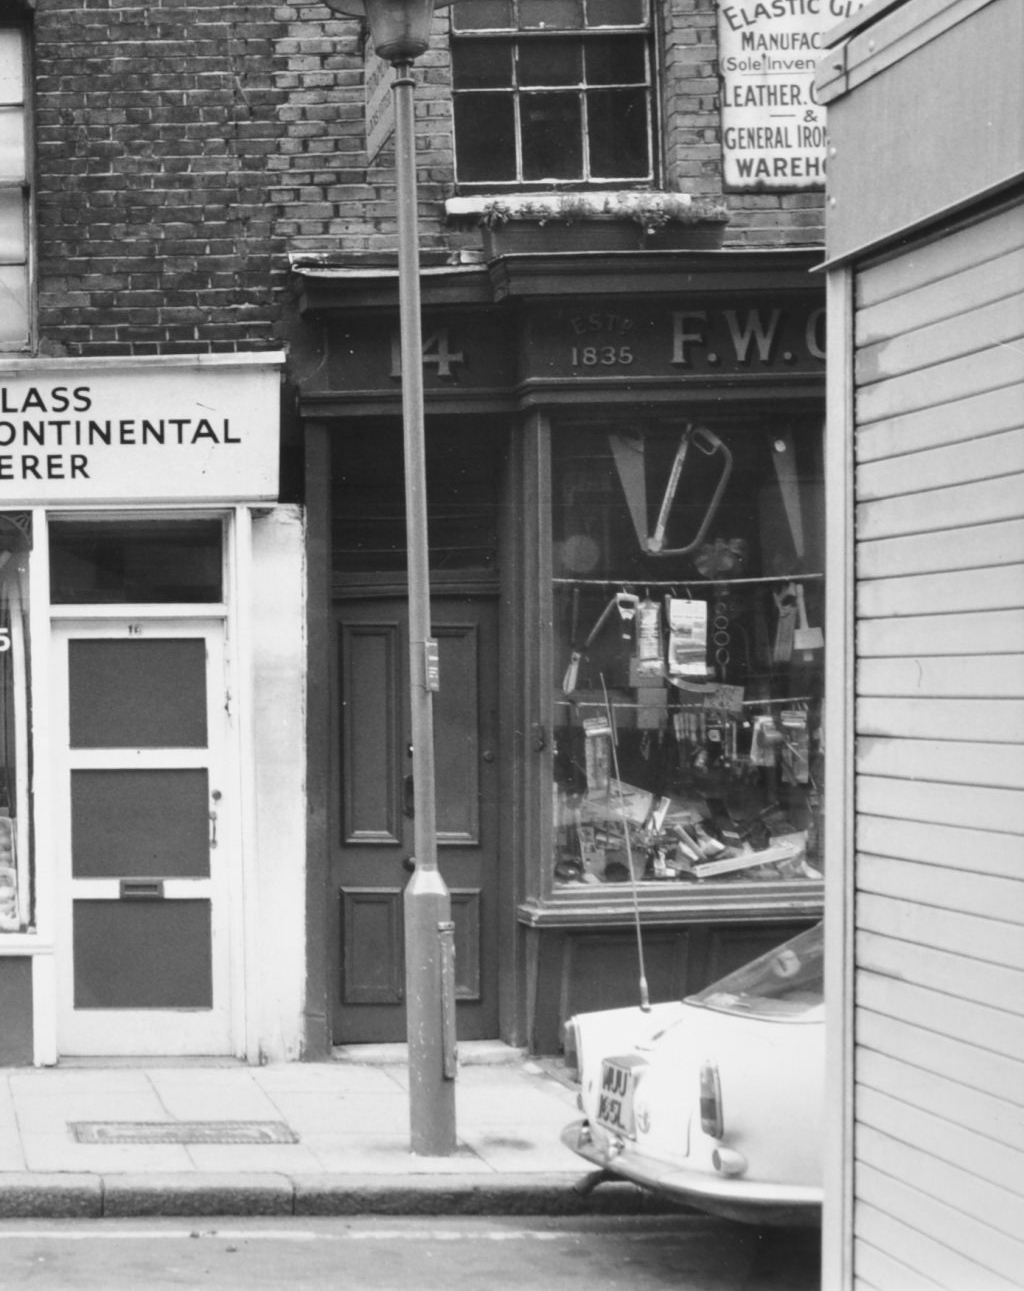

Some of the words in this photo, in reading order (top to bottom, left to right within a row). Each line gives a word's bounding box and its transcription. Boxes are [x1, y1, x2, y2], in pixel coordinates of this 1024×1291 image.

[742, 31, 826, 51] MANUFAC
[767, 56, 819, 73] Inven
[803, 109, 818, 123] &
[724, 128, 793, 150] GENERAL
[572, 346, 633, 366] 1835
